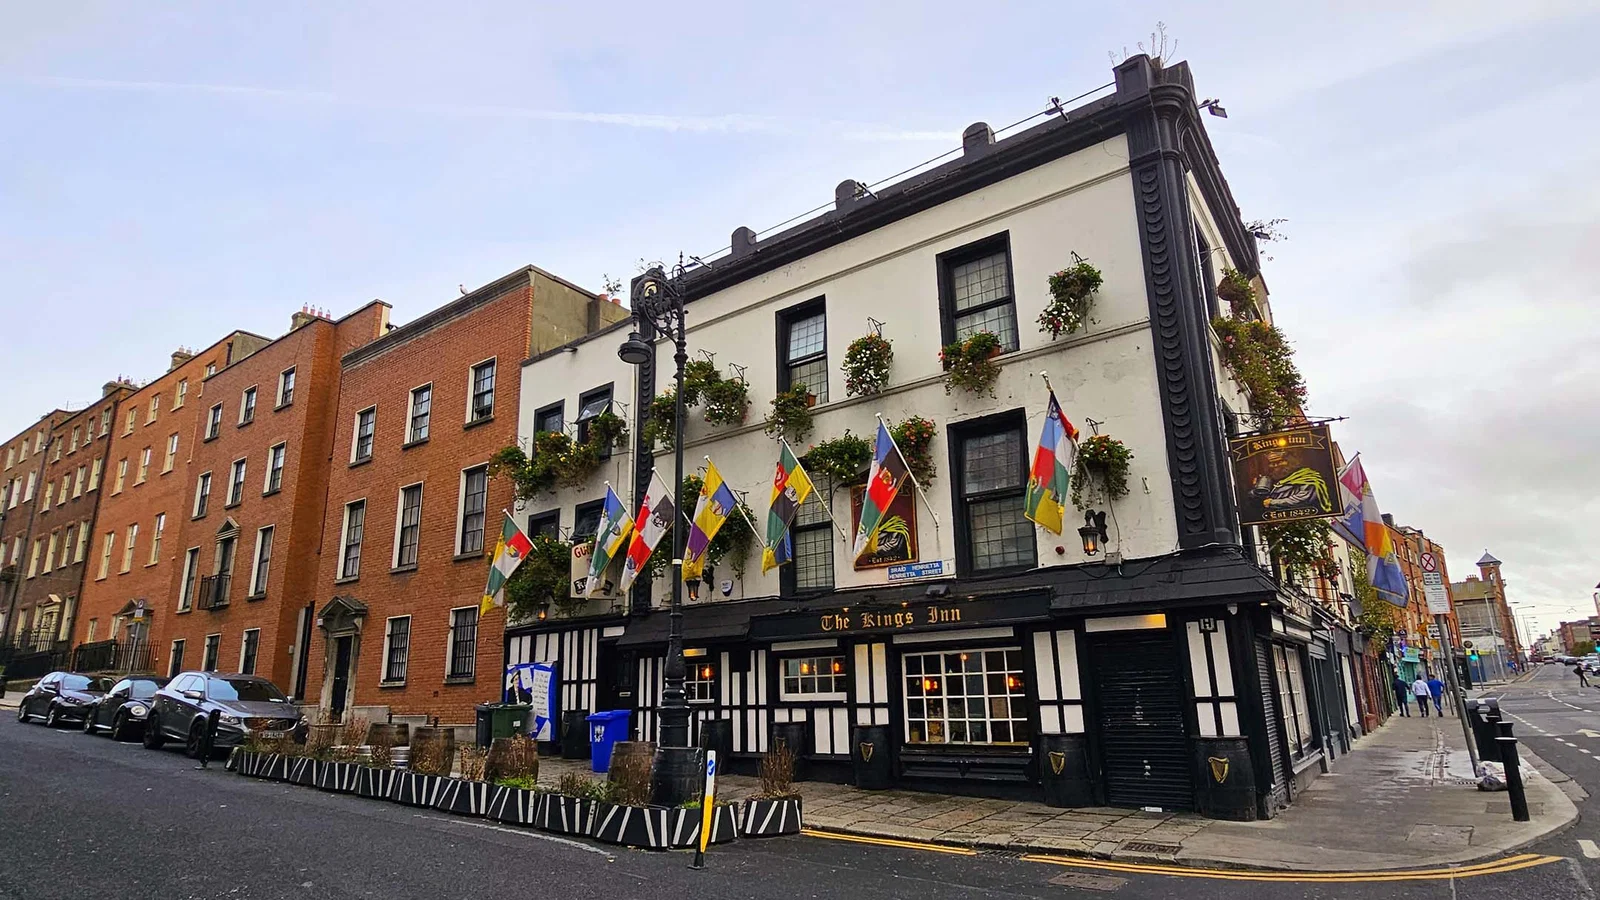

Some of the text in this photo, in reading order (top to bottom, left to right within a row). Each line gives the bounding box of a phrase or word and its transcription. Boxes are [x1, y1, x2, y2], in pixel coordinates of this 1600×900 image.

[1252, 438, 1286, 450] King
[1270, 511, 1287, 519] Est
[911, 562, 940, 570] HENRIETTA
[889, 568, 942, 579] HENRIETTA STREET
[820, 605, 961, 632] The Kings Inn
